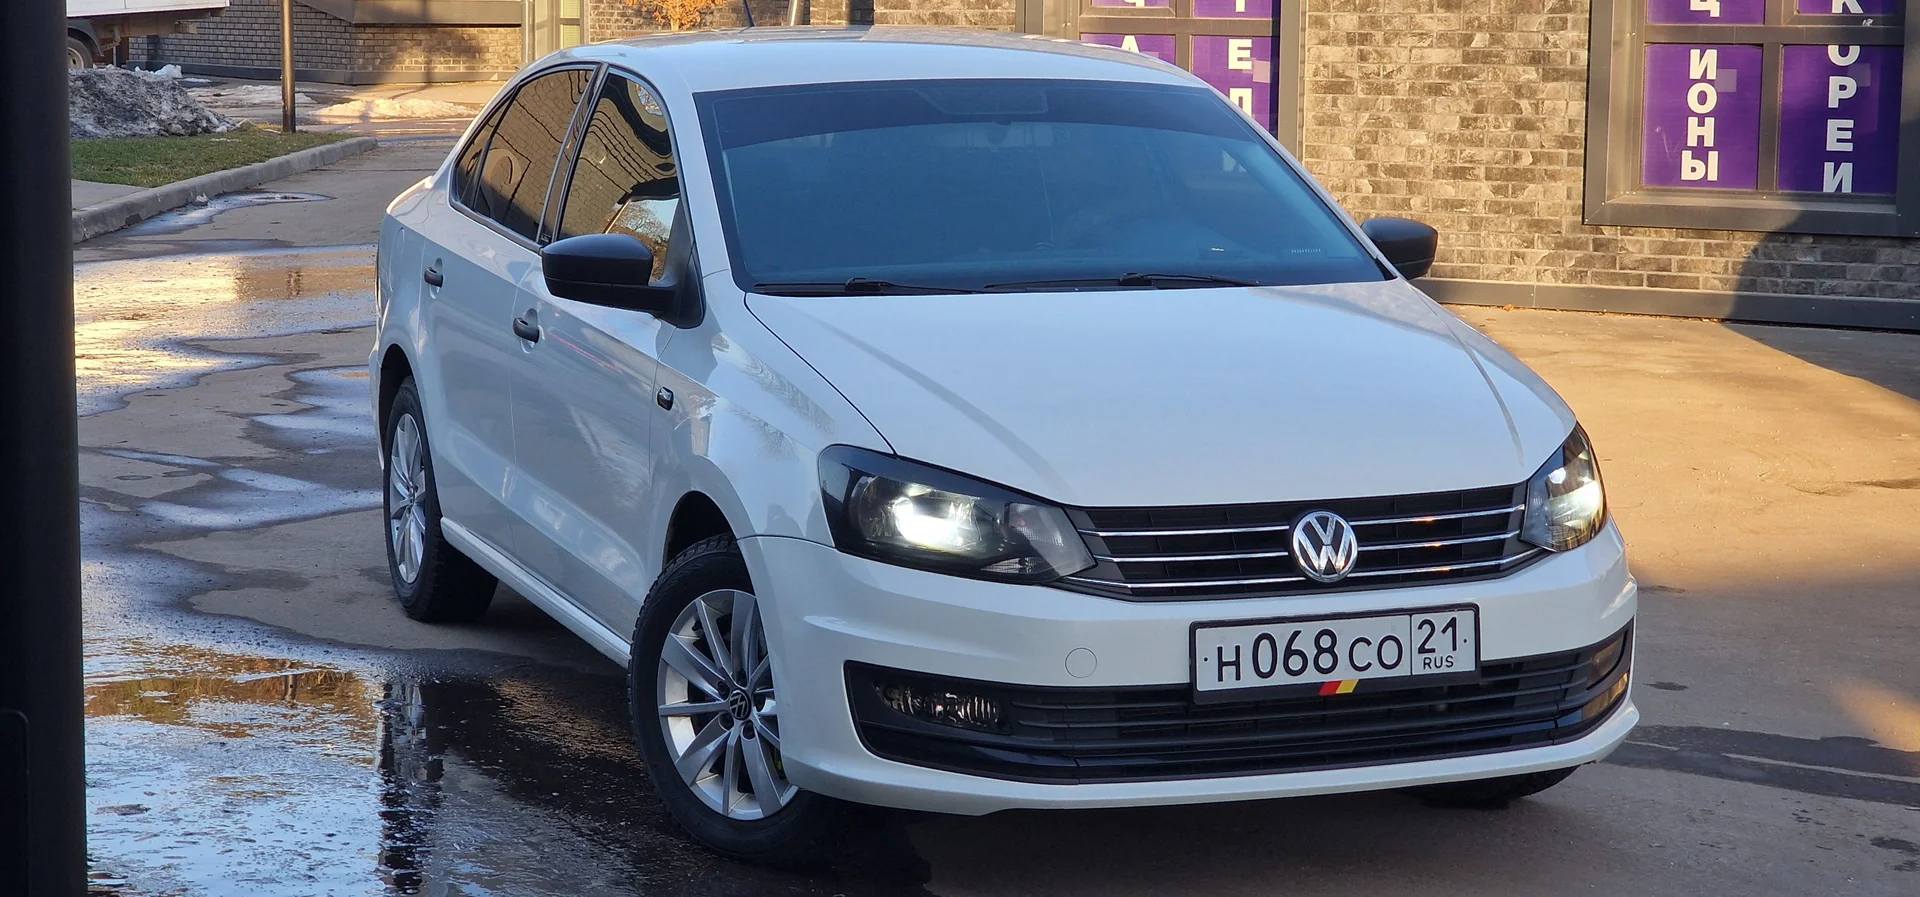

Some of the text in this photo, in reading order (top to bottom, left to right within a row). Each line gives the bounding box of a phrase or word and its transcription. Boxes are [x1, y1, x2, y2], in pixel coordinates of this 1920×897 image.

[1293, 510, 1358, 582] VW
[1417, 616, 1457, 655] 21
[1423, 655, 1455, 670] RUS
